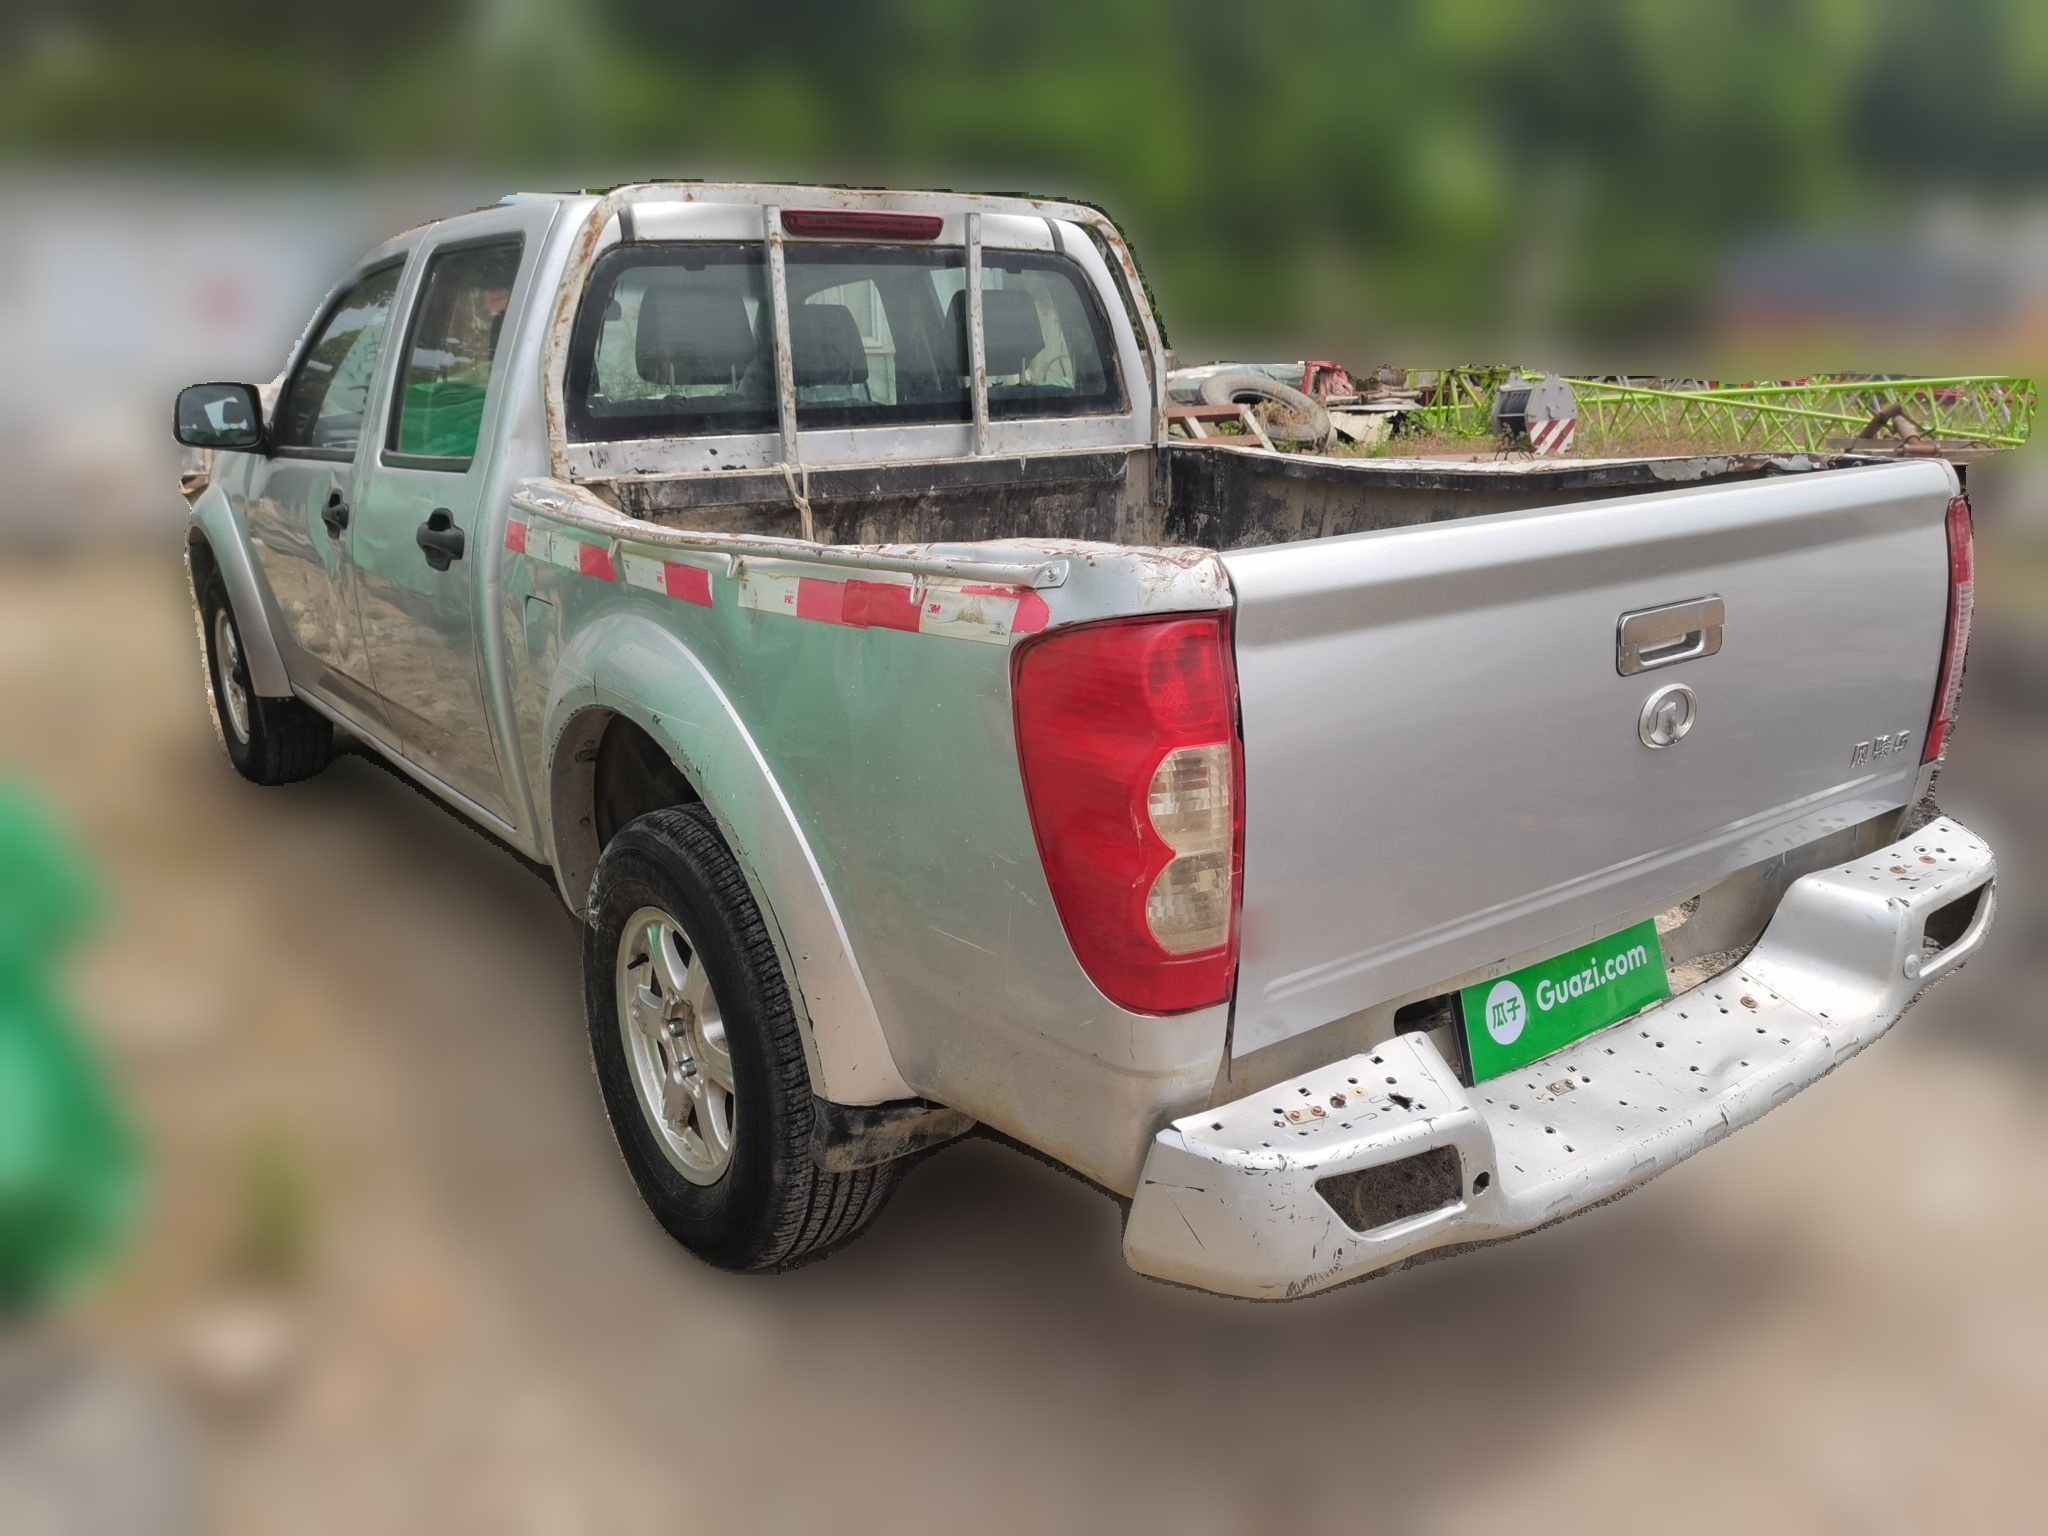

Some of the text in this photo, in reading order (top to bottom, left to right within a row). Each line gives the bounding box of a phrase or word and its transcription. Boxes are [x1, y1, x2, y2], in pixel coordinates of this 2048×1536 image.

[927, 604, 941, 613] 3M
[1536, 944, 1648, 1011] Guazi.com
[1491, 995, 1522, 1030] 瓜子
